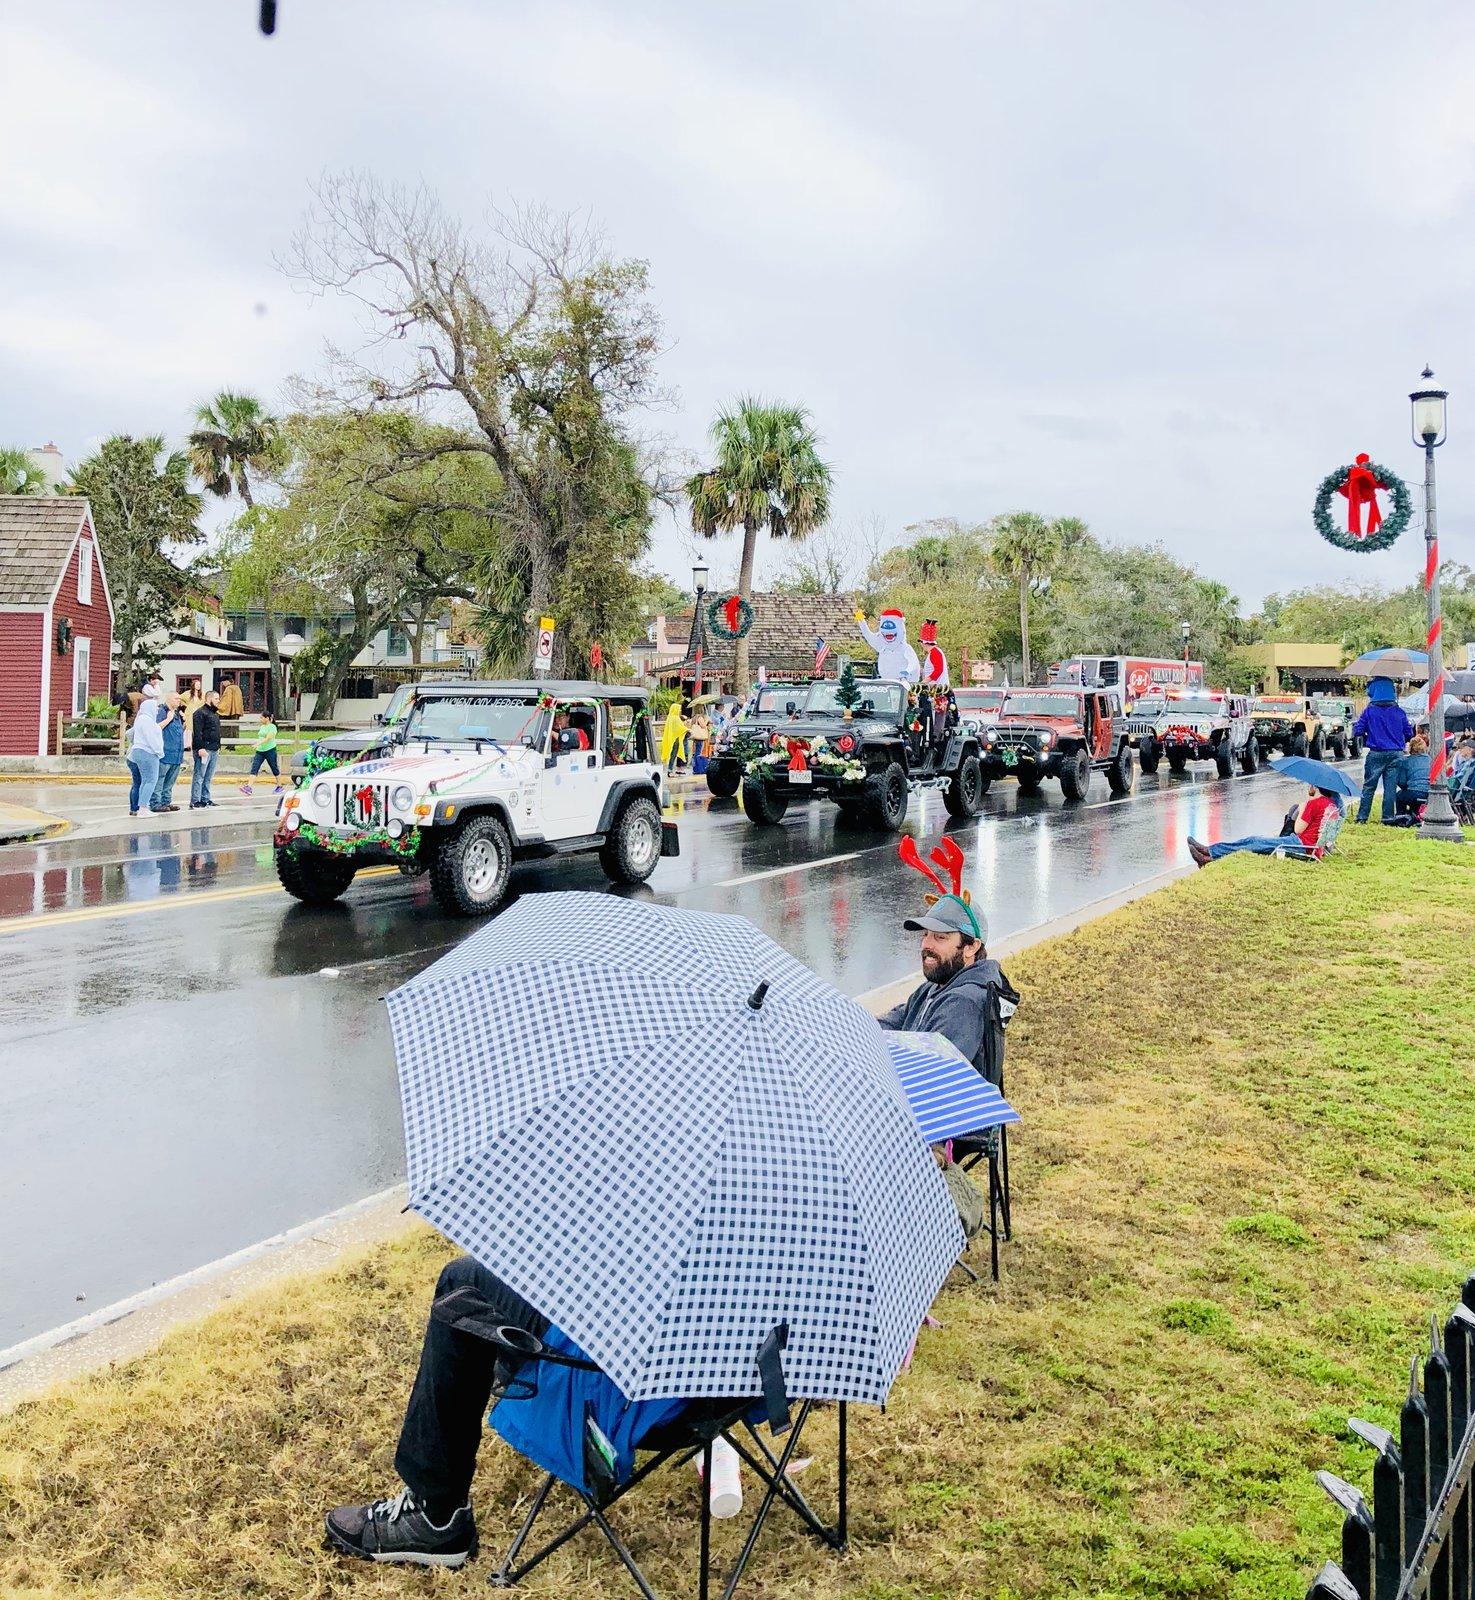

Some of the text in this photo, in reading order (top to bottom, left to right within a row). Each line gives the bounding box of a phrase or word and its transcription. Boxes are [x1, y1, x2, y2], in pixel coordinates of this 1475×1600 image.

[441, 697, 526, 708] ANCIENT CITY JEEPERS
